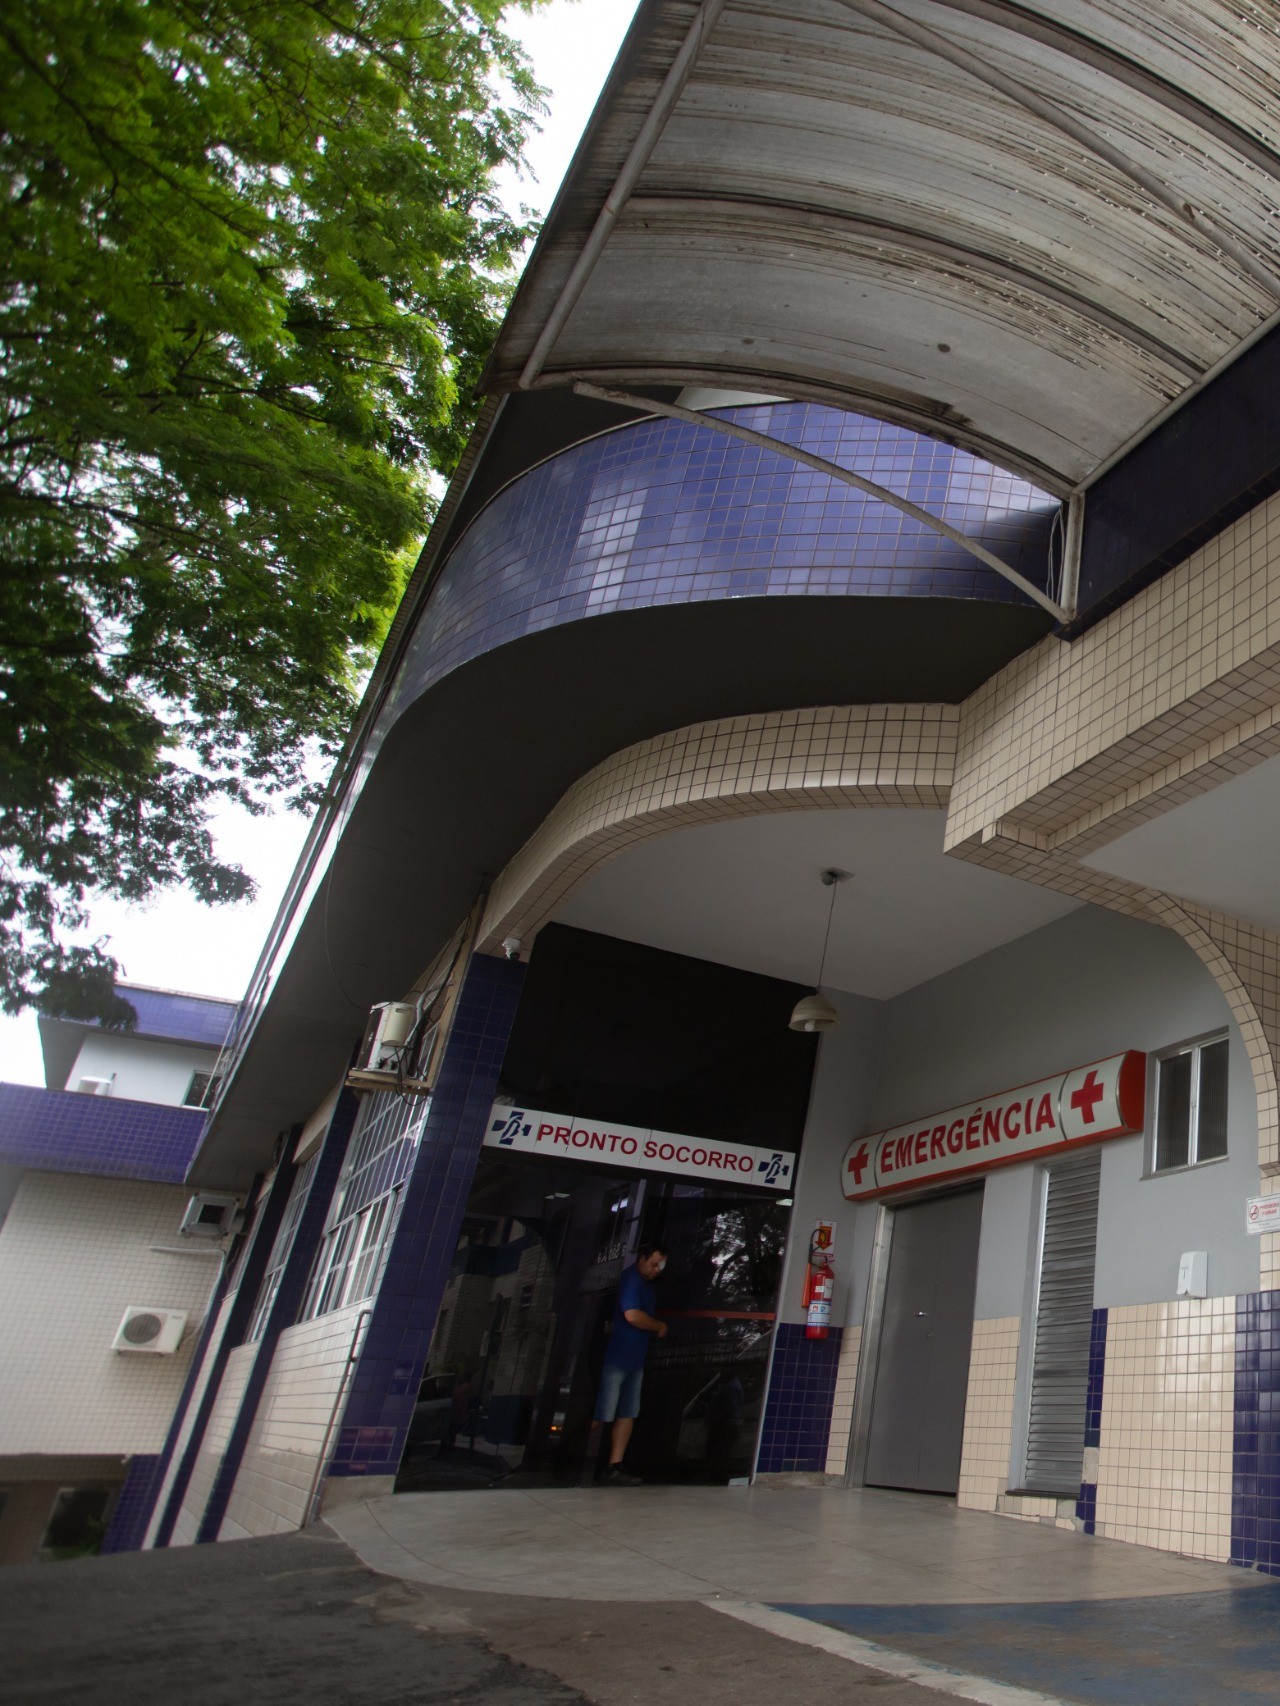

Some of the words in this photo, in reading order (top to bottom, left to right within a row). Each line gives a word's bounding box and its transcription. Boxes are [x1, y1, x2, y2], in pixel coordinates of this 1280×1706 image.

[536, 1124, 638, 1155] PRONTO
[643, 1141, 754, 1173] SOCORRO
[880, 1092, 1056, 1174] EMERGÊNCIA
